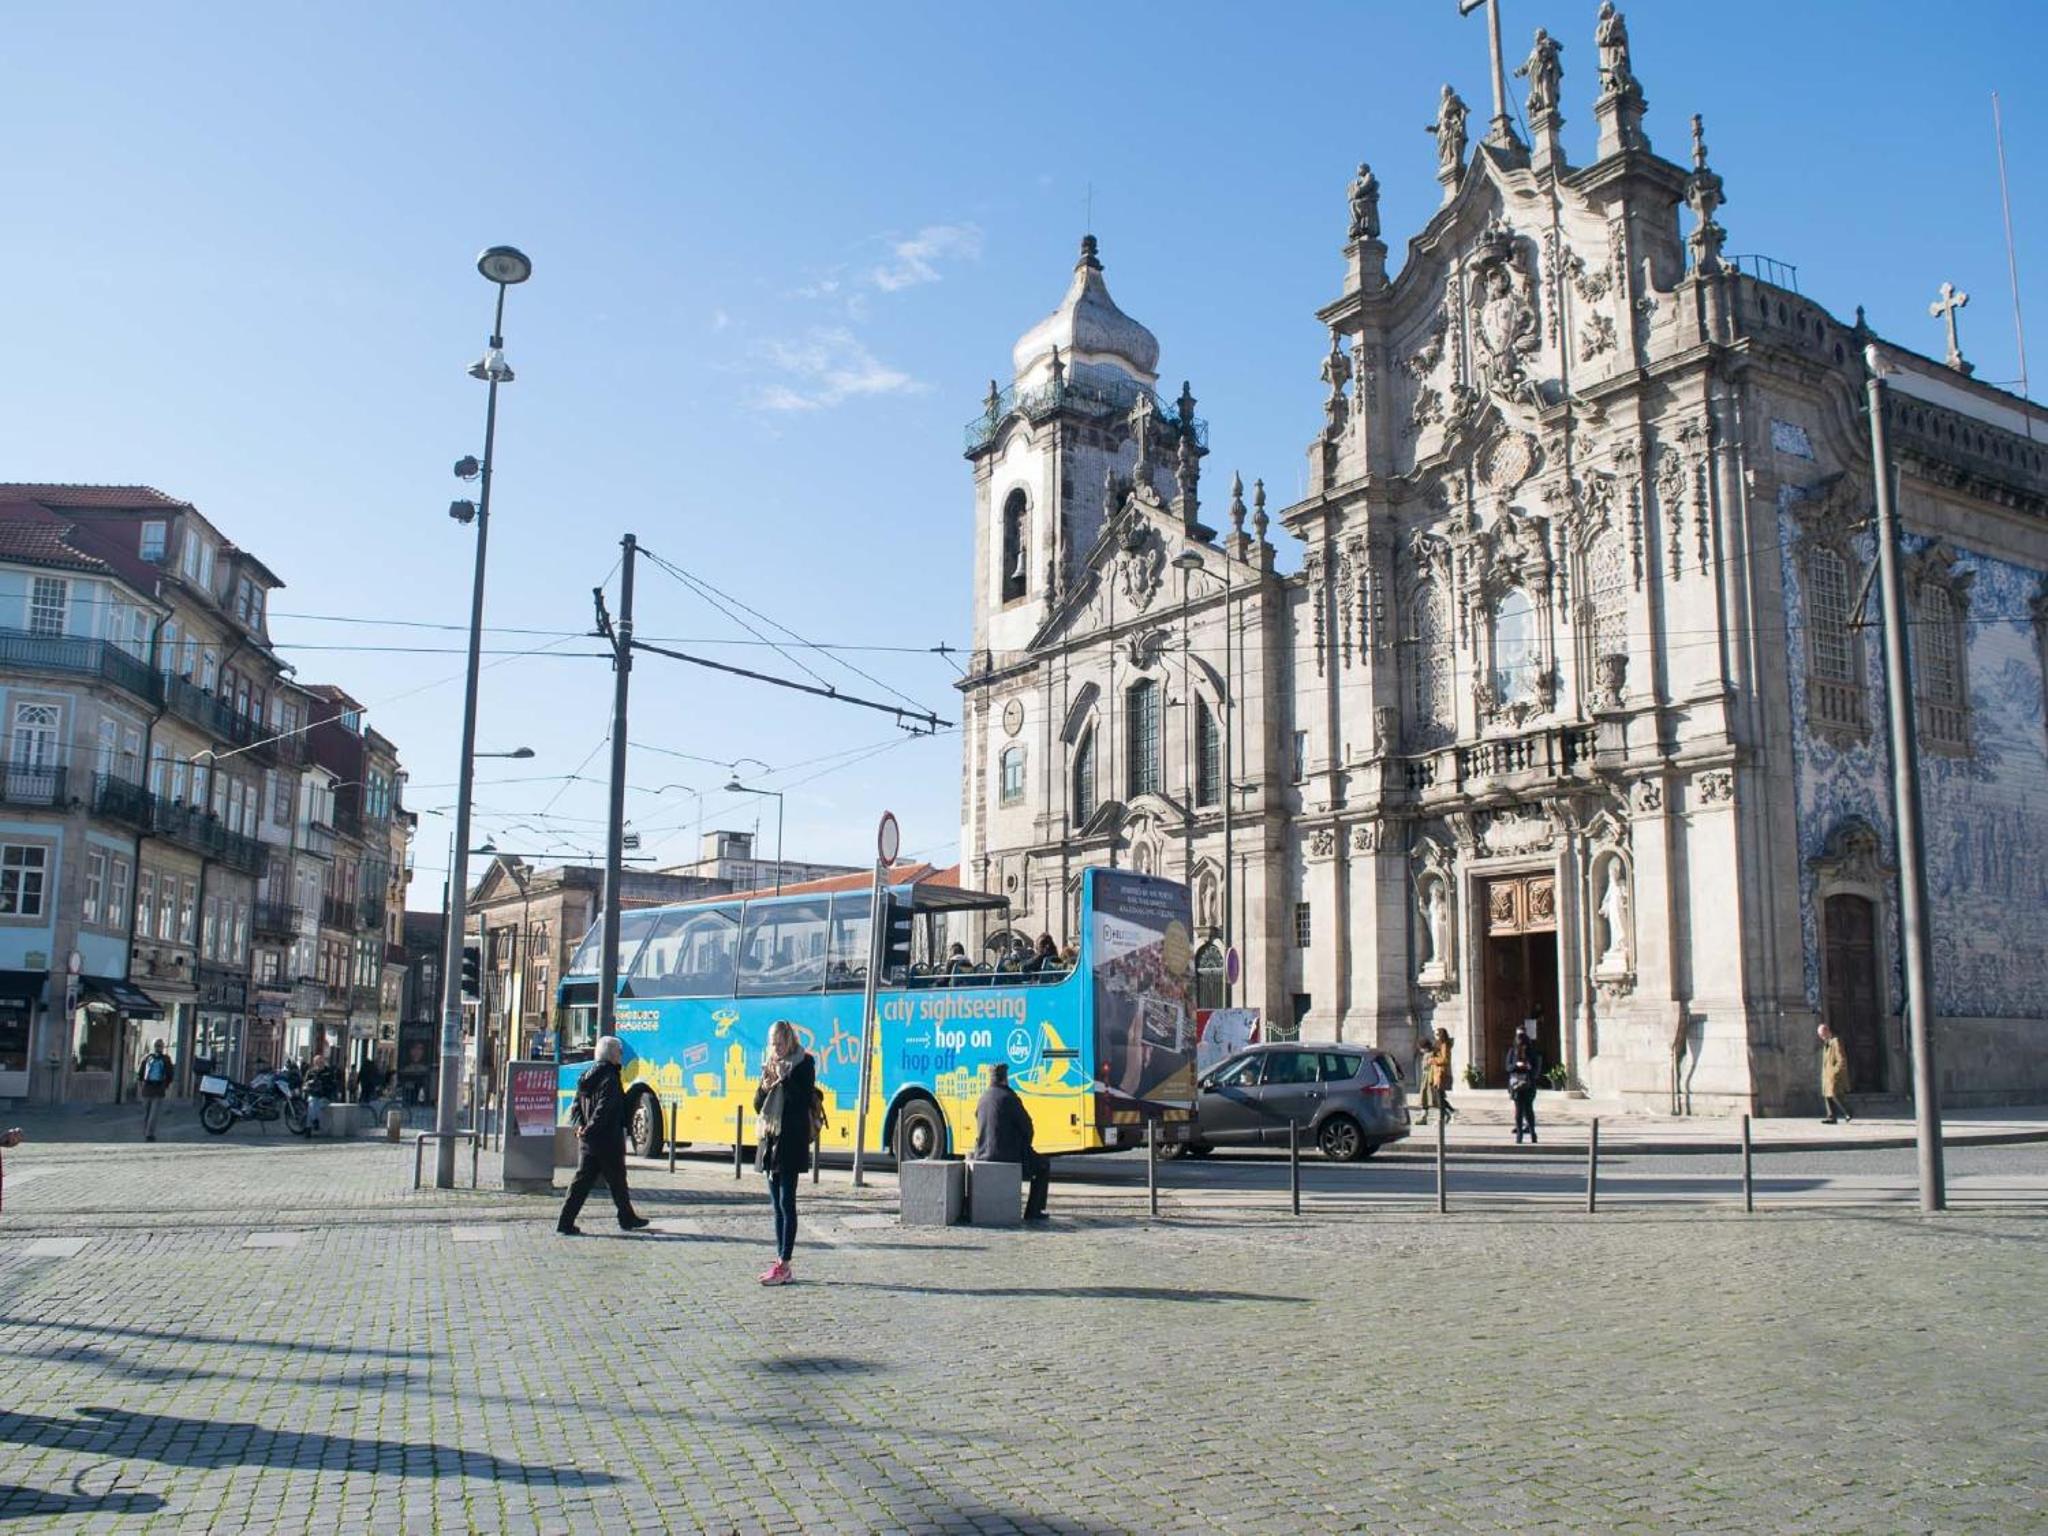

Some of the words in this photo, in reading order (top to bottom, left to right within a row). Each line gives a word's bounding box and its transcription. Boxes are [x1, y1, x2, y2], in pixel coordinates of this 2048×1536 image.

[884, 998, 914, 1028] city
[920, 994, 1027, 1027] sightseeing
[935, 1025, 966, 1054] hop
[970, 1029, 992, 1048] on
[1009, 1043, 1028, 1057] days
[902, 1048, 929, 1074] hop
[934, 1047, 956, 1071] off
